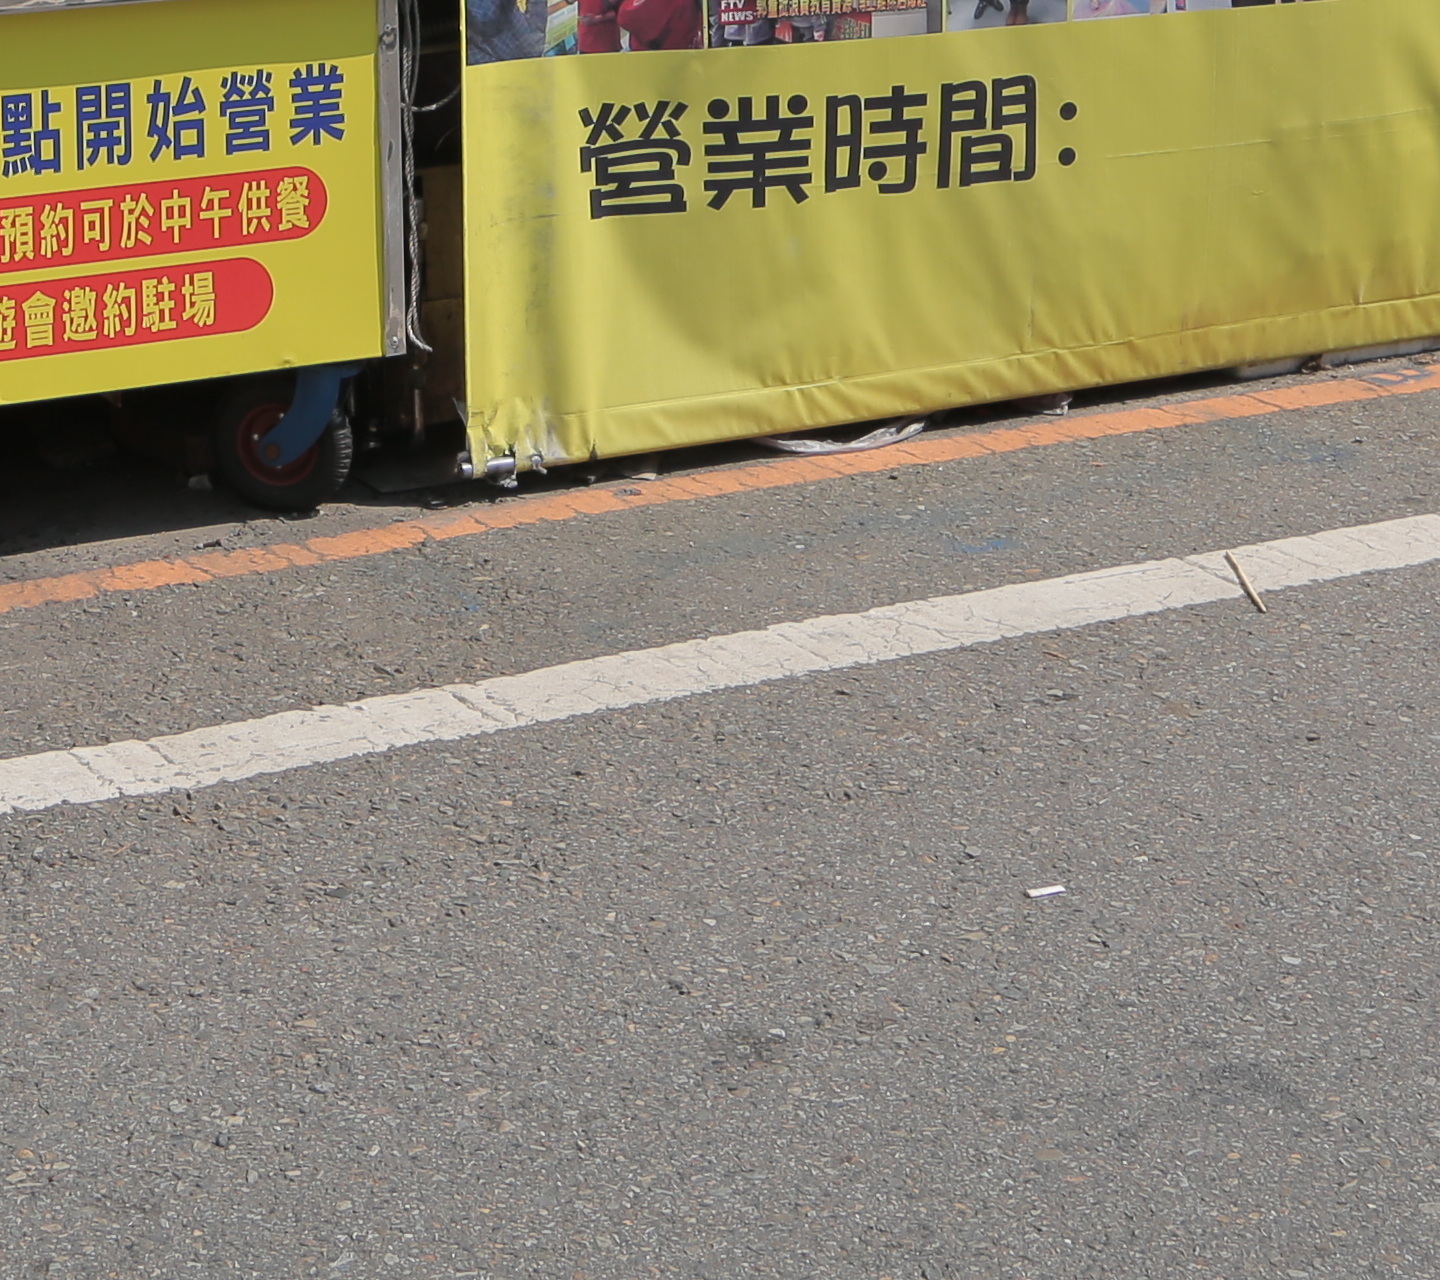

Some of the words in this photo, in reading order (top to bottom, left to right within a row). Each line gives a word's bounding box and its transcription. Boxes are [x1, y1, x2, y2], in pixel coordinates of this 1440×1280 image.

[721, 0, 745, 10] FTV
[721, 11, 753, 22] NEWS
[579, 73, 1078, 221] 營業時間:
